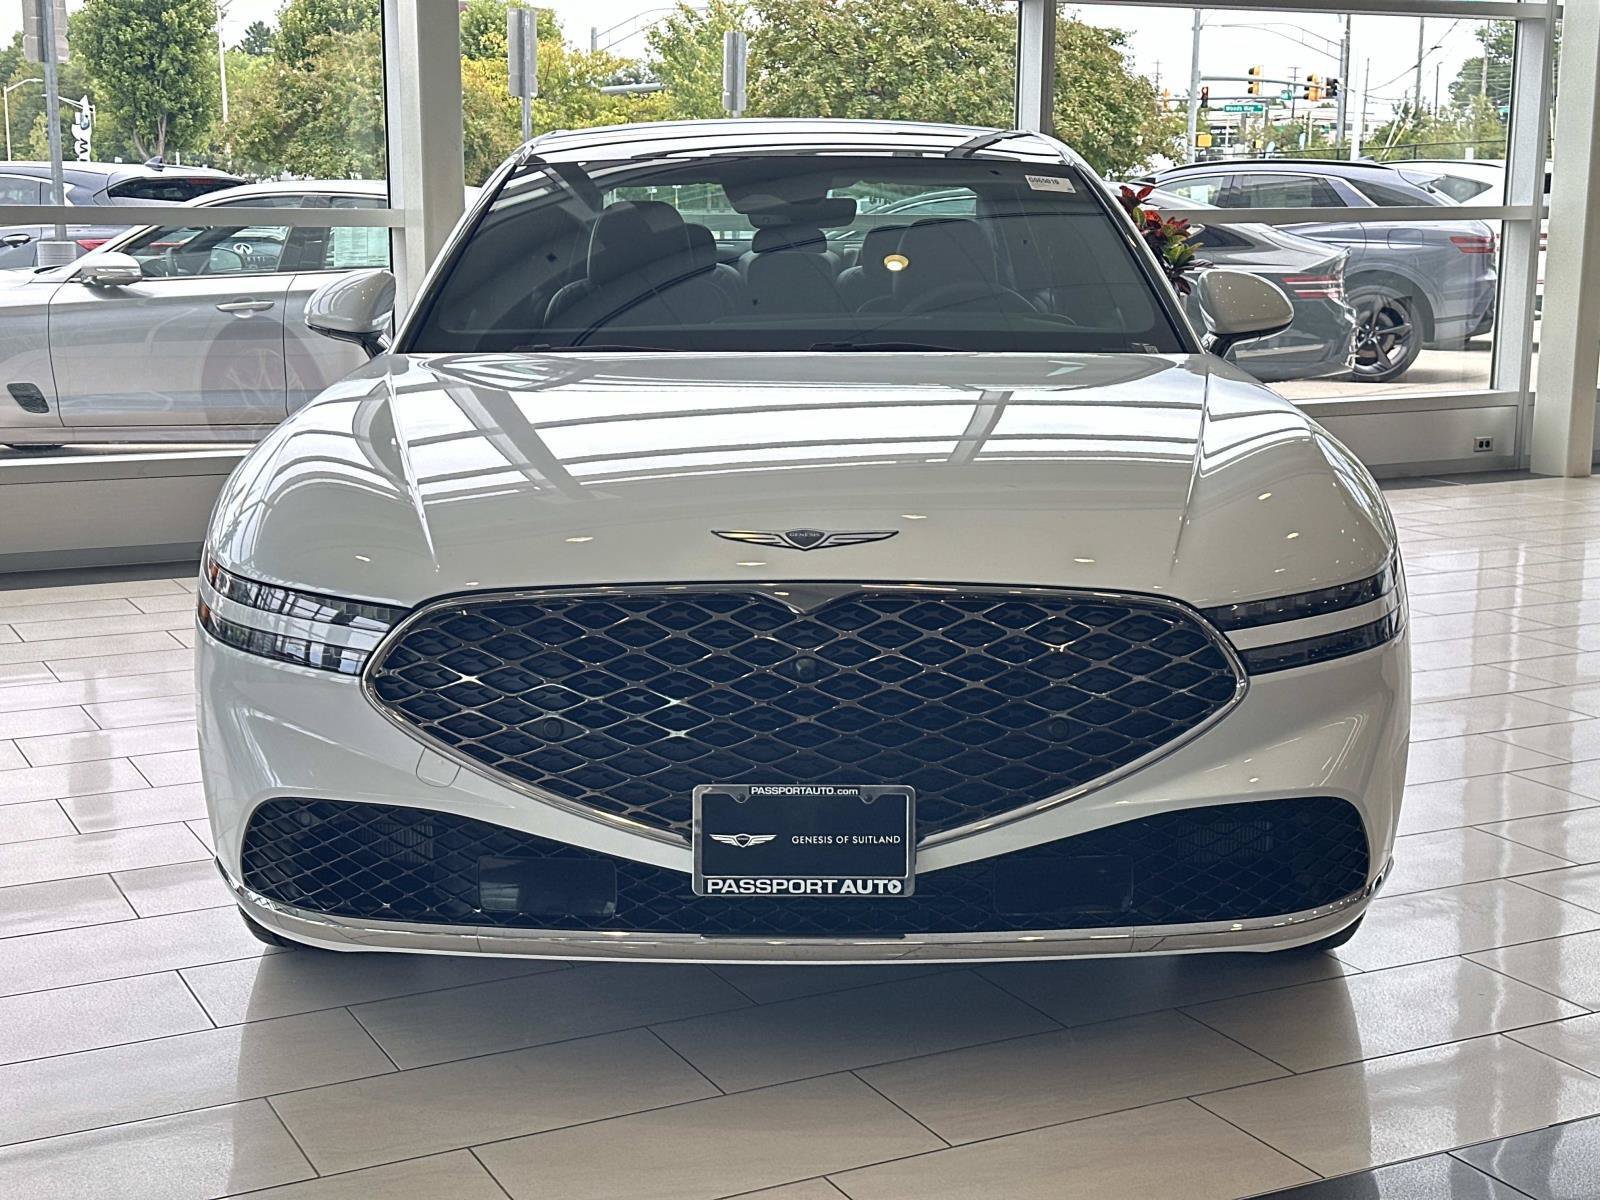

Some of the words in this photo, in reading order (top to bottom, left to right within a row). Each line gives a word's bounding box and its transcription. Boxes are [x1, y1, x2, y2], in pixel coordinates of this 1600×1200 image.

[751, 786, 859, 795] PASSPORTAUTO.com
[791, 835, 833, 844] GENESIS
[835, 835, 849, 844] OF
[852, 835, 901, 844] SUITLAND
[707, 879, 838, 894] PASSPORT
[839, 879, 902, 894] AUTO
